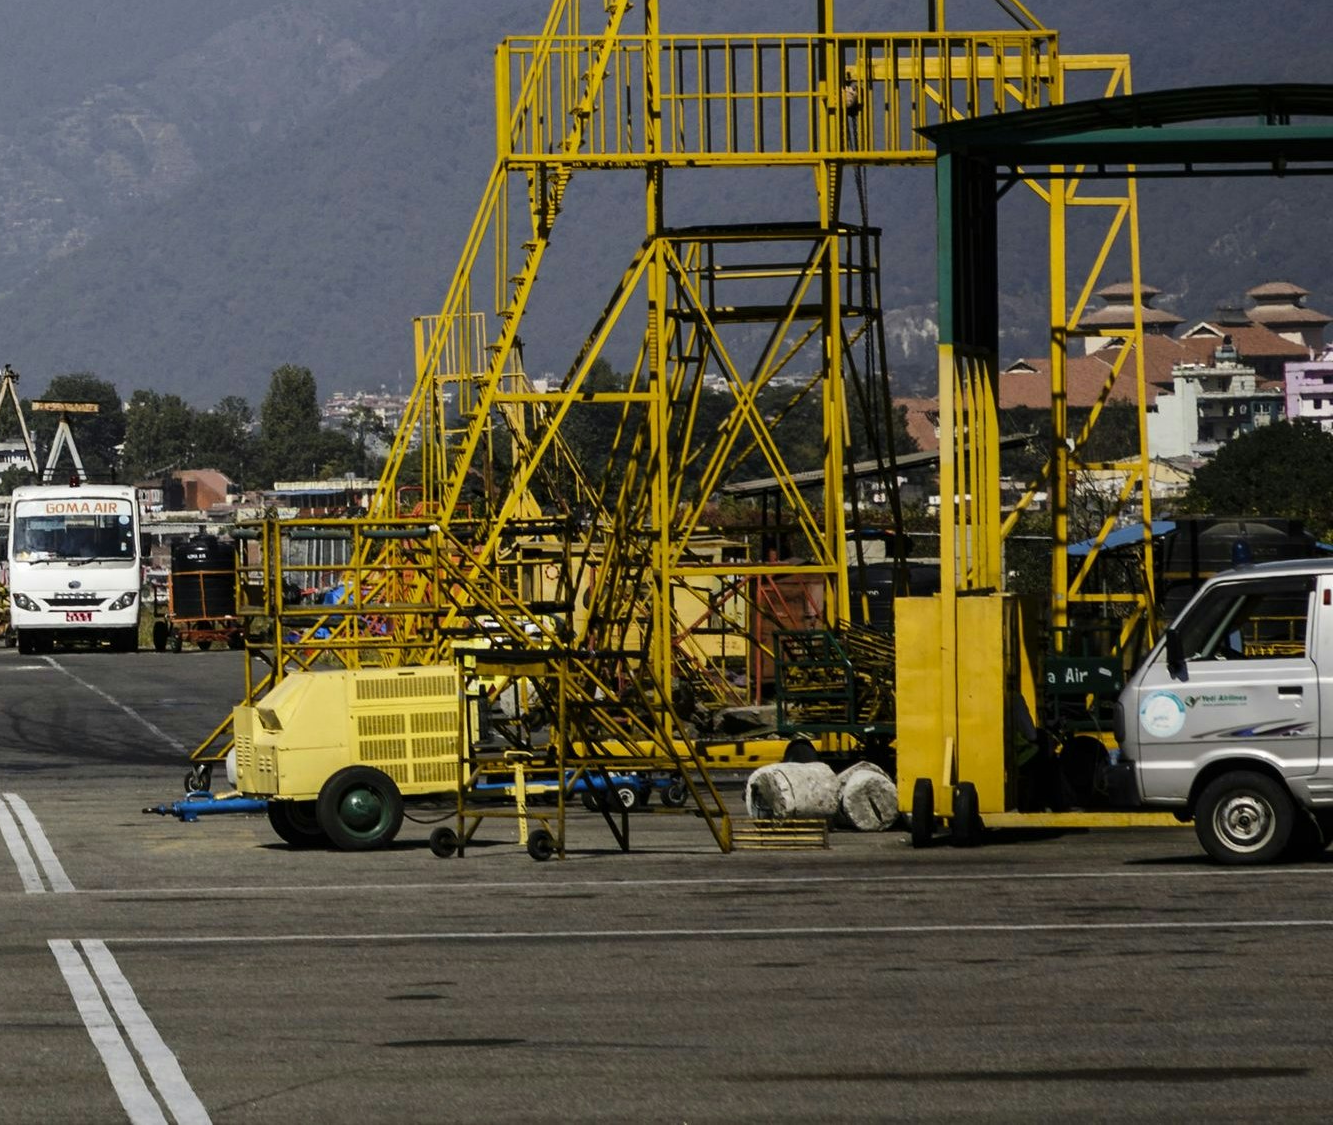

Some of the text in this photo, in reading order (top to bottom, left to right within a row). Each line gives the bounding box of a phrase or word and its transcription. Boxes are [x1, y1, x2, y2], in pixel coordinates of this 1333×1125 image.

[45, 502, 118, 514] GOMA AIR
[1065, 667, 1089, 684] Air
[1219, 694, 1247, 702] Airlines
